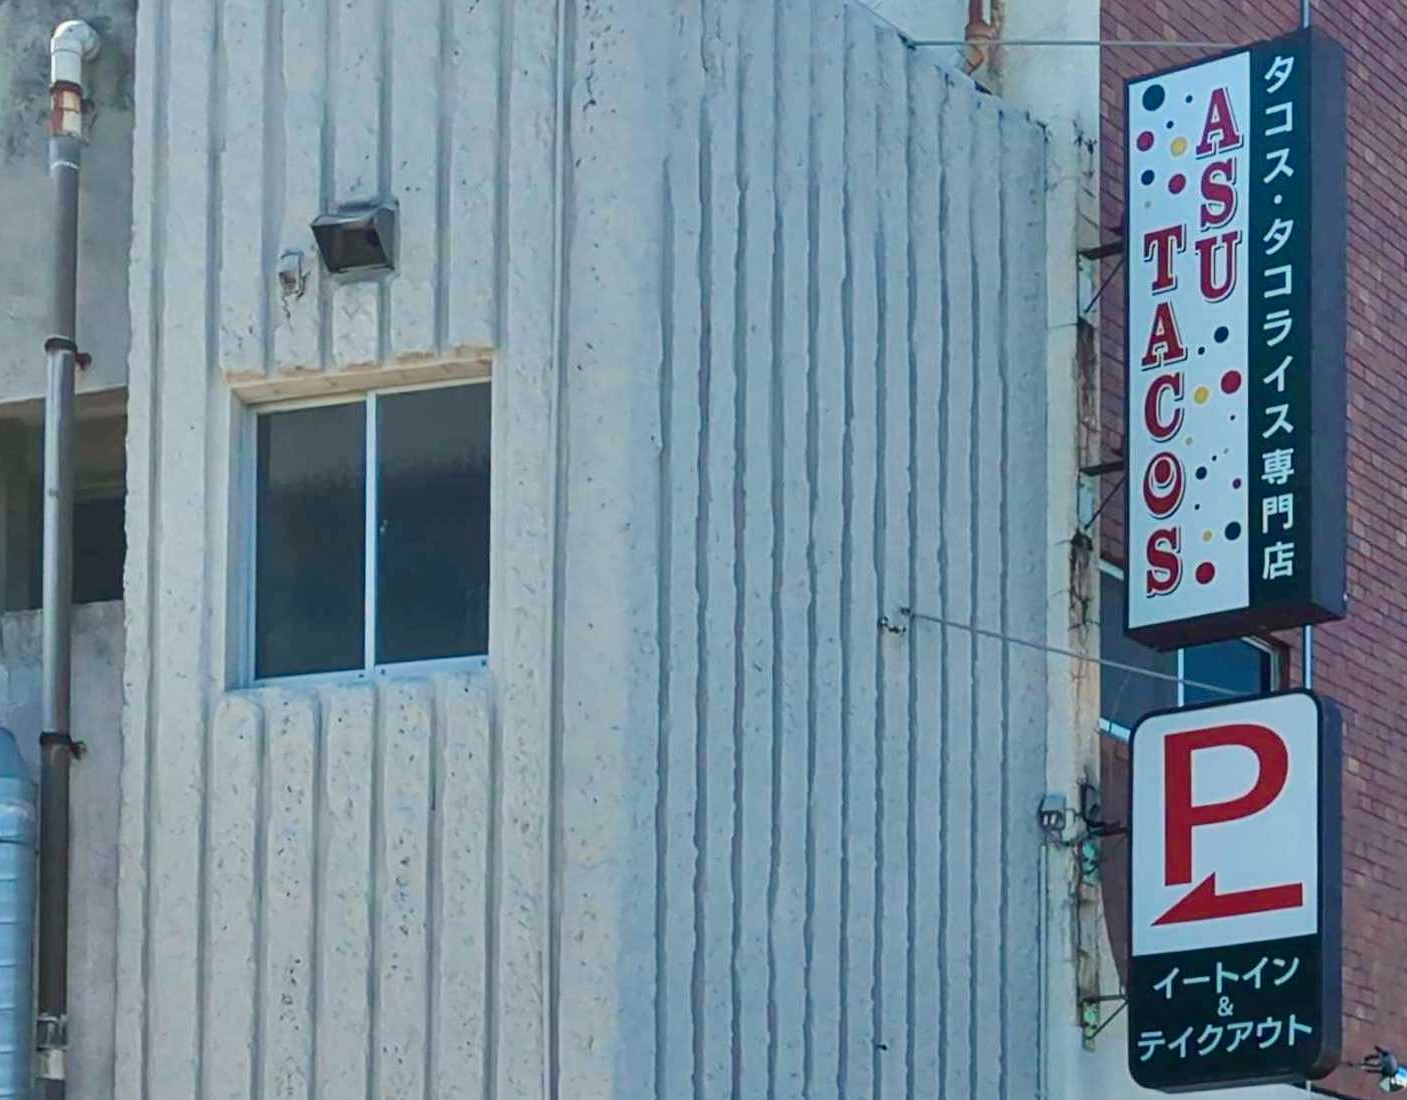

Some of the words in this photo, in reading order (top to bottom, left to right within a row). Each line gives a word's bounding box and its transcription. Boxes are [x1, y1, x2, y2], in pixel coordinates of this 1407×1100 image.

[1196, 87, 1243, 304] ASU
[1261, 55, 1296, 581] タコス・タコライス専門店
[1141, 224, 1187, 598] TACOS
[1164, 723, 1289, 888] P
[1137, 1014, 1313, 1062] テイクアウト
[1152, 956, 1300, 999] イートイン
[1216, 996, 1234, 1017] &
